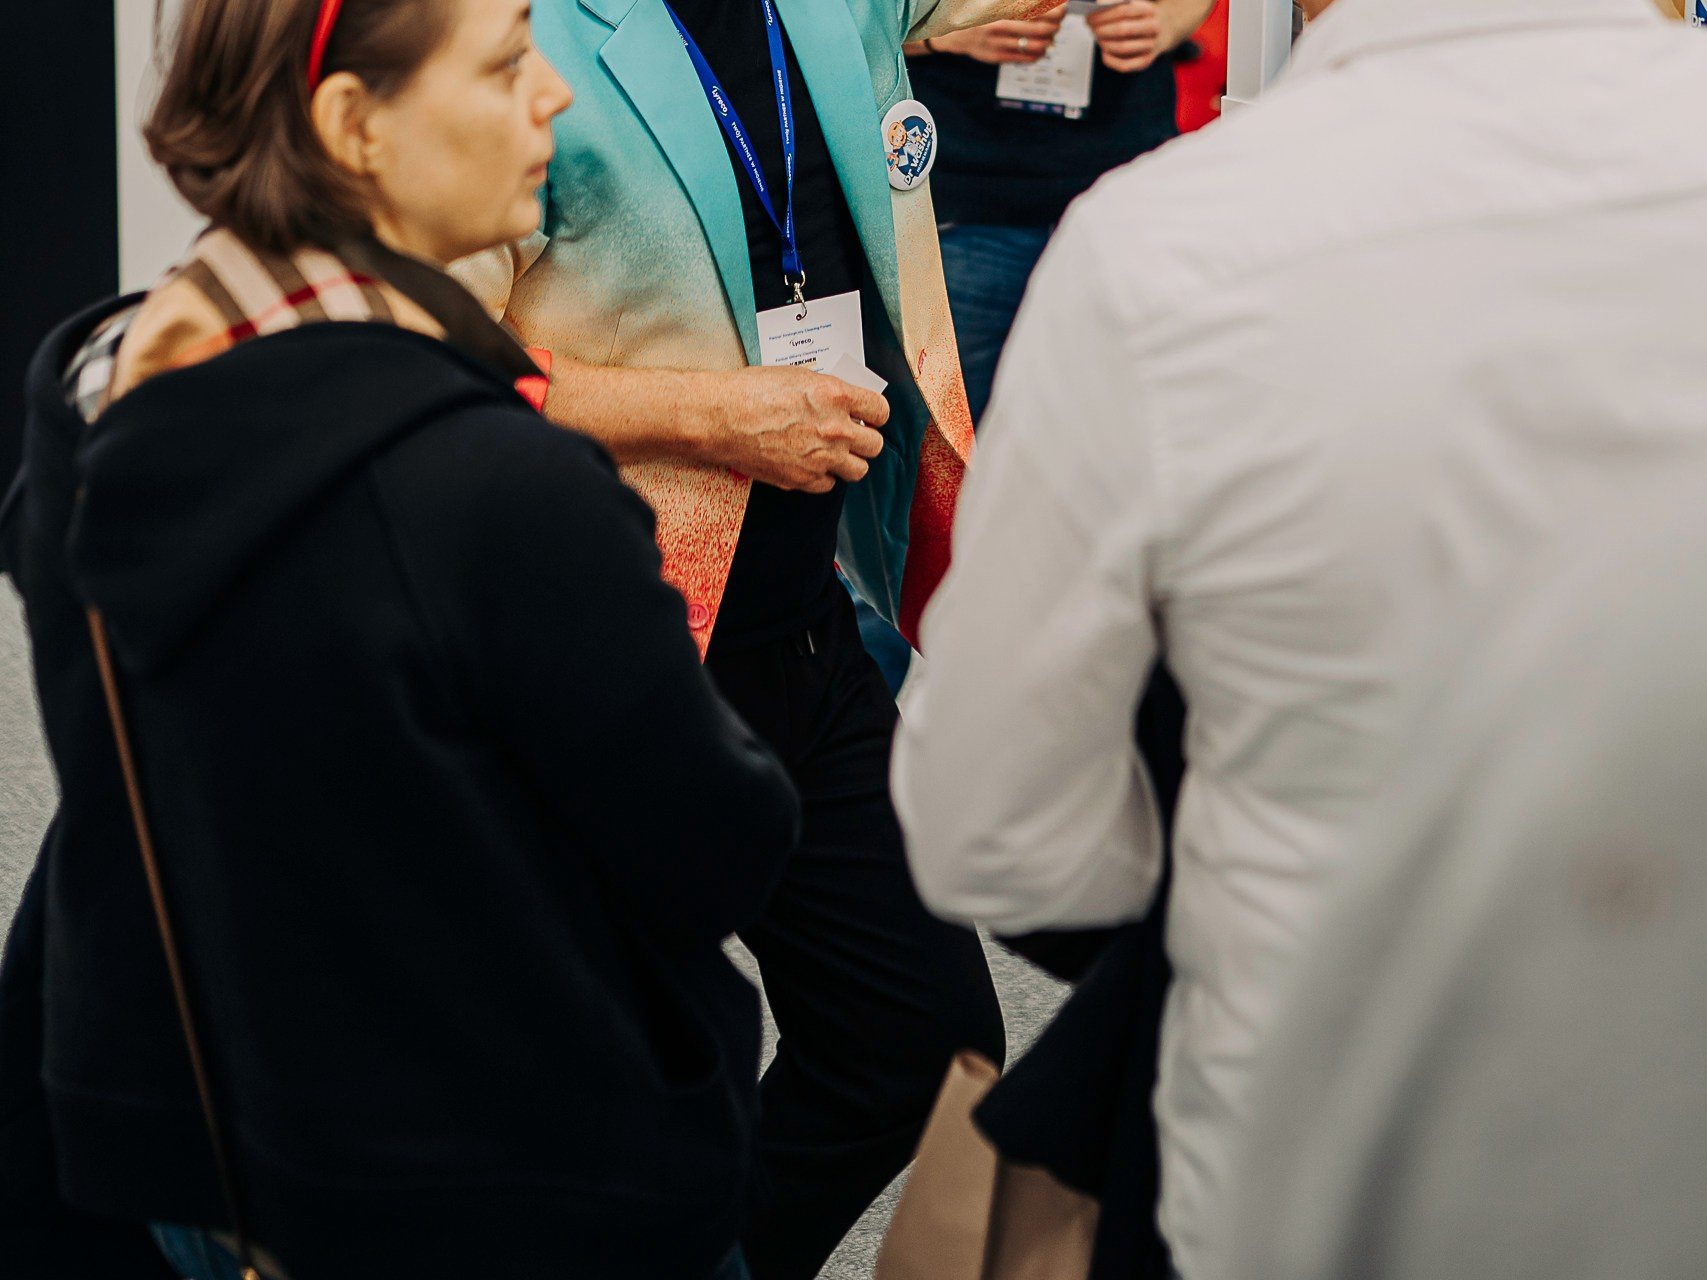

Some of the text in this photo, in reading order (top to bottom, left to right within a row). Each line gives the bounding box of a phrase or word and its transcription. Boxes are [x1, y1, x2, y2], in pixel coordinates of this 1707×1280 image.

[712, 89, 728, 113] Lyreco
[904, 168, 914, 186] Dr
[792, 338, 812, 347] Lyreco
